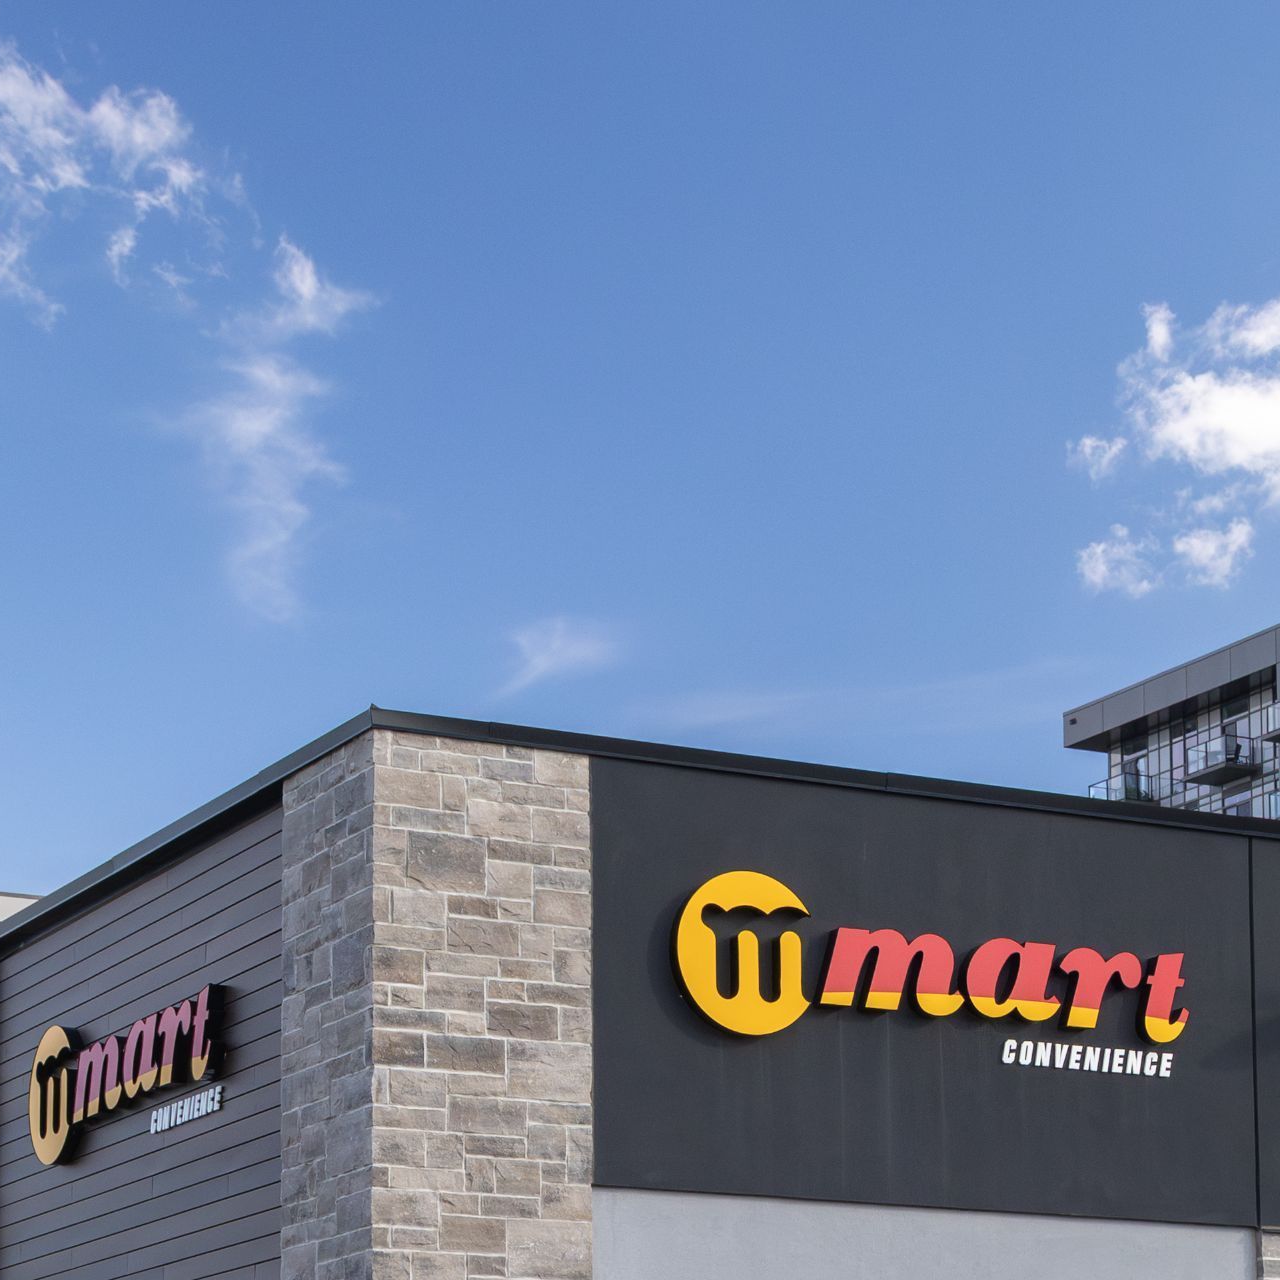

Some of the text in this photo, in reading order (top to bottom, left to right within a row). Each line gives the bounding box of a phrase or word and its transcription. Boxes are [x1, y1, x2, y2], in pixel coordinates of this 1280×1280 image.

[819, 926, 1190, 1044] mart
[72, 984, 212, 1124] mart
[1000, 1039, 1174, 1078] CONVENIENCE
[149, 1085, 222, 1134] CONVENIENCE
